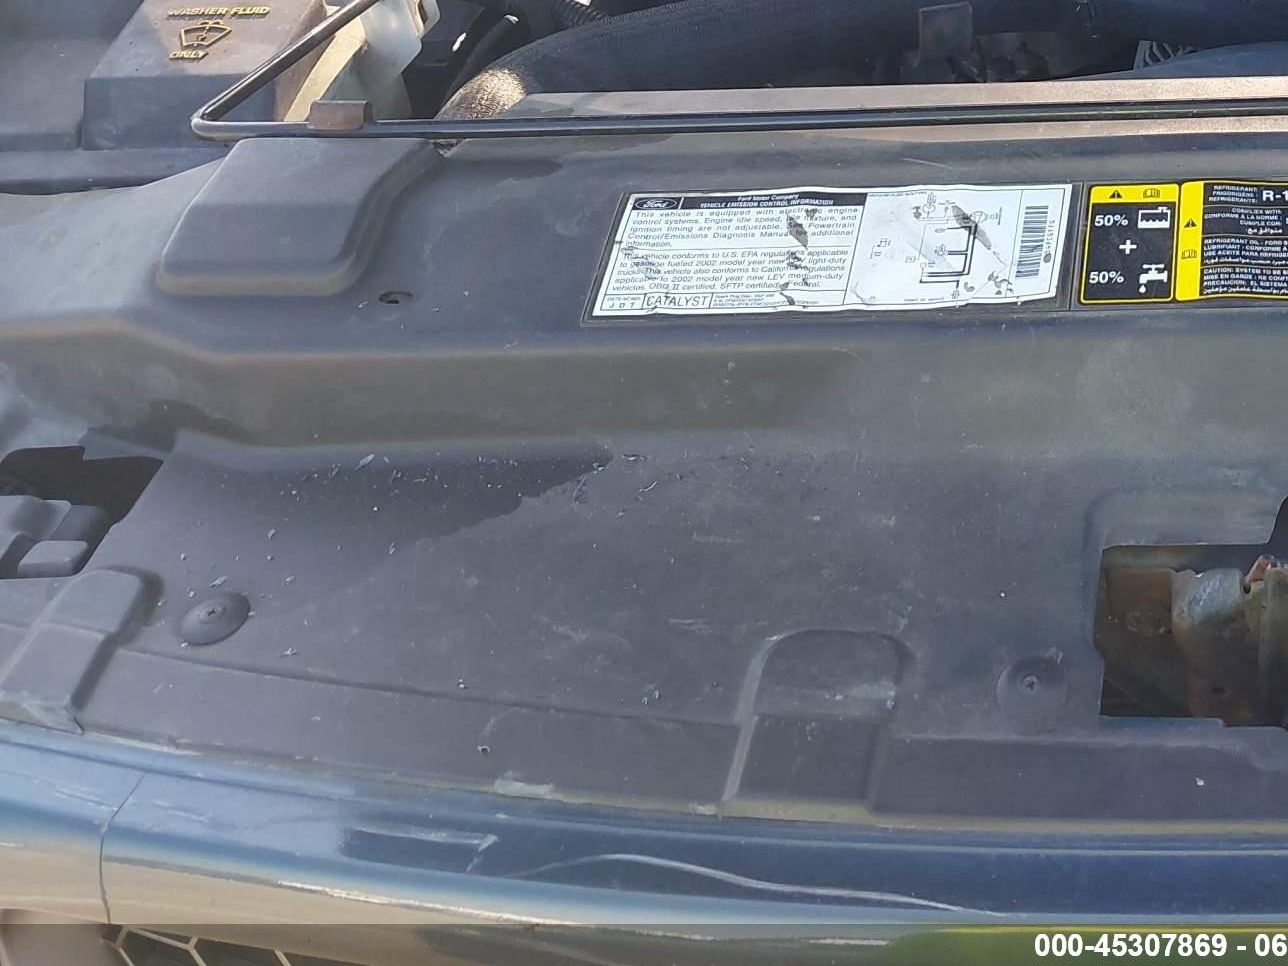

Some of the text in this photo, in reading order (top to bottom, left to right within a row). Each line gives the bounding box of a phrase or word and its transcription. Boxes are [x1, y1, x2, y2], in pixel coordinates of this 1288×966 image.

[167, 6, 272, 18] WASHER FLUID
[168, 50, 209, 60] ONLY
[771, 193, 800, 201] Company
[643, 199, 669, 209] Ford
[700, 201, 726, 209] VEHICLE
[727, 200, 758, 208] EMISSION
[790, 198, 834, 206] INFORMATION
[709, 210, 751, 219] equipped
[756, 208, 774, 216] with
[704, 217, 734, 225] Engine
[755, 216, 783, 224] speed,
[1094, 214, 1129, 227] 50%
[630, 225, 663, 233] ignition
[666, 225, 694, 233] timing
[735, 224, 783, 232] adjustable.
[808, 222, 855, 230] Powertrain
[628, 232, 709, 240] Control/Emissions
[713, 232, 755, 240] Diagnosis
[811, 229, 854, 237] additional
[625, 240, 672, 248] information.
[672, 252, 709, 260] conforms
[741, 250, 759, 258] EPA
[807, 249, 848, 257] applicable
[695, 259, 718, 267] 2002
[748, 258, 766, 266] year
[808, 256, 847, 266] light-duty
[645, 267, 661, 275] This
[693, 267, 710, 275] also
[712, 266, 749, 275] conforms
[1203, 267, 1234, 275] CAUTION:
[671, 275, 694, 283] 2002
[725, 275, 744, 283] year
[767, 273, 785, 281] LEV
[787, 272, 844, 281] medium-duty
[1088, 271, 1125, 284] 50%
[671, 282, 744, 291] II certified. SFTP
[646, 294, 710, 307] CATALYST
